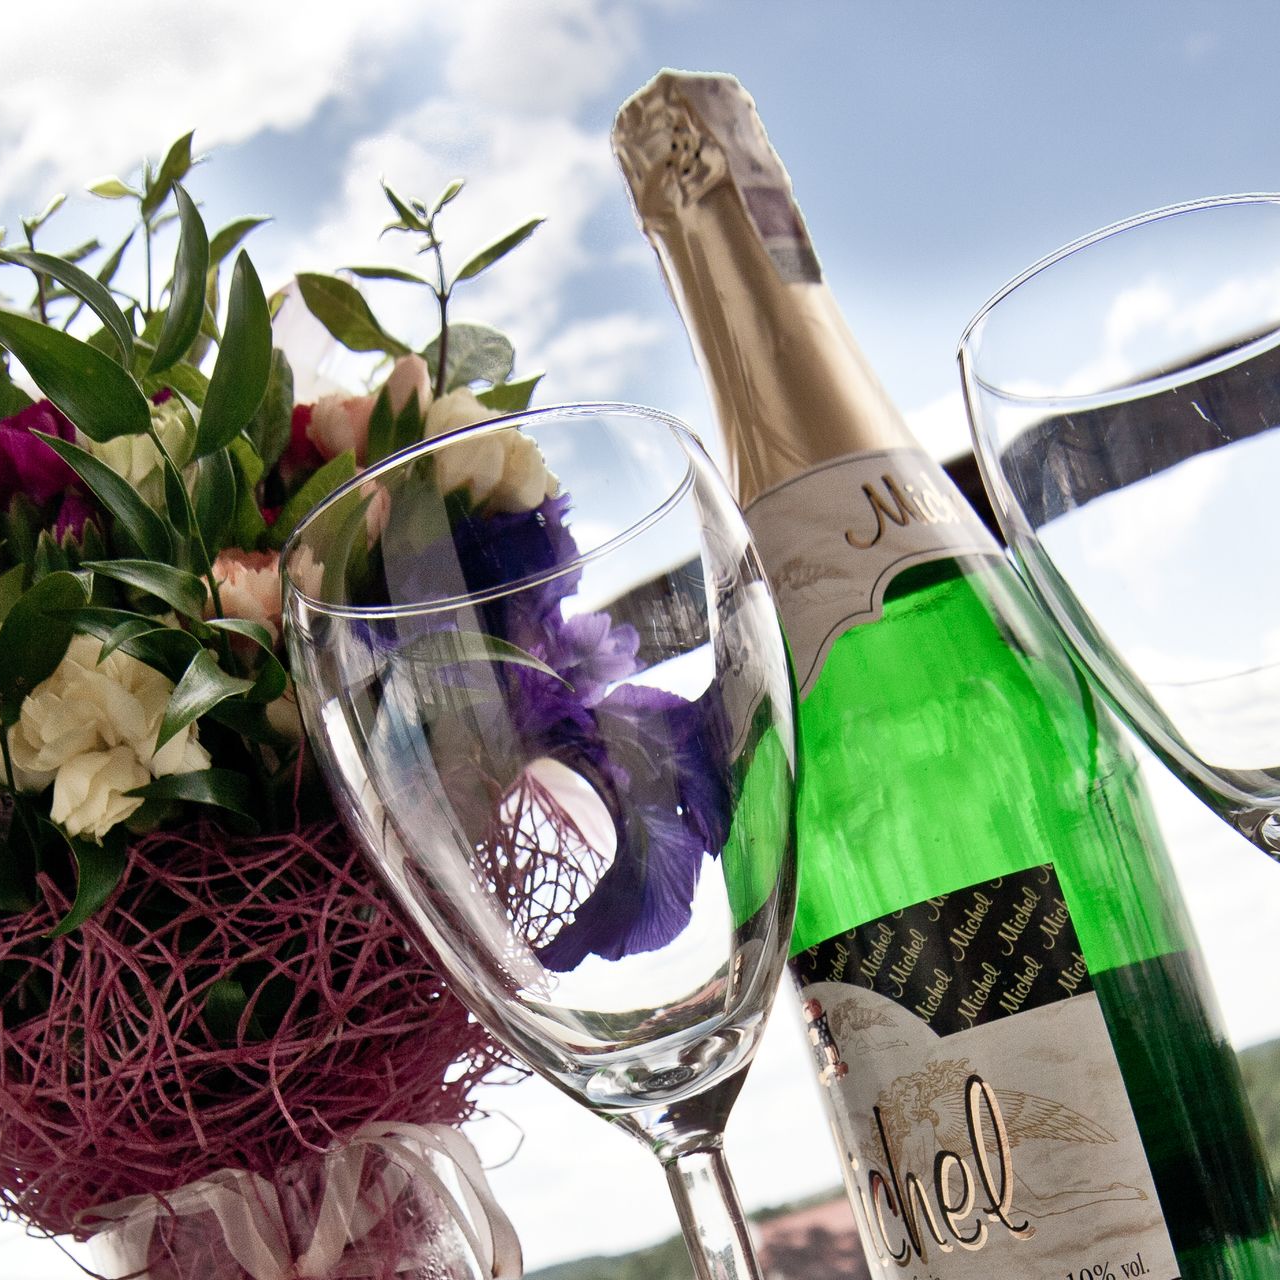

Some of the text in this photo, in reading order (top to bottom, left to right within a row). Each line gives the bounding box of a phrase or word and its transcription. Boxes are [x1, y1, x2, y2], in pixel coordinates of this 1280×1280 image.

[949, 892, 994, 962] Michel
[998, 887, 1041, 957] Michel
[825, 942, 850, 983] ichel
[860, 922, 896, 991] Michel
[888, 928, 928, 998] Michel
[999, 955, 1043, 1015] Michel
[957, 962, 1001, 1029] Michel
[1120, 1252, 1150, 1279] vol.
